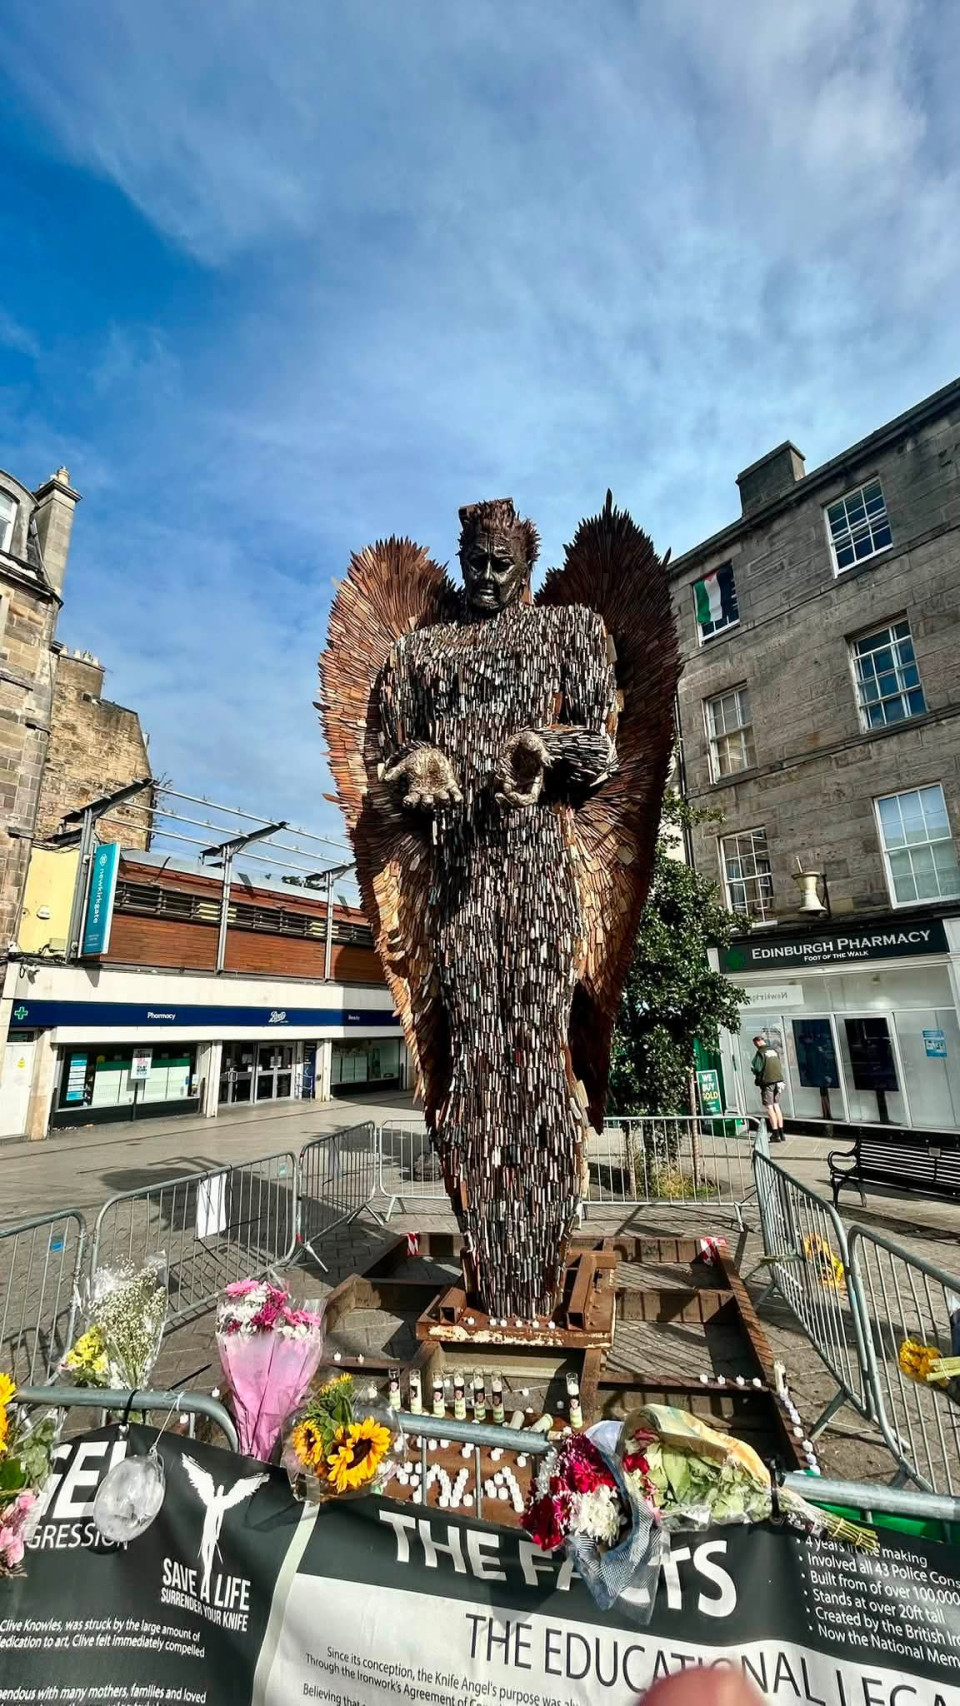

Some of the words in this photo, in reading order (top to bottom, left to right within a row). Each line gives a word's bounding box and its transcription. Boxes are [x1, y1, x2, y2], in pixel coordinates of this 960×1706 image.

[93, 868, 105, 923] newkirkgate
[752, 941, 834, 960] EDINBURGH
[837, 930, 931, 951] PHARMACY
[847, 950, 870, 958] WALK
[147, 1011, 176, 1021] Pharmacy
[268, 1011, 287, 1023] Boots
[702, 1073, 713, 1082] WE
[702, 1082, 715, 1092] BUY
[378, 1509, 507, 1582] THE
[805, 1535, 813, 1548] 4
[814, 1537, 845, 1552] years
[882, 1547, 928, 1568] making
[807, 1552, 857, 1572] Involved
[859, 1559, 873, 1575] all
[875, 1563, 890, 1578] 43
[891, 1563, 928, 1582] Police
[162, 1557, 198, 1597] SAVE
[214, 1573, 251, 1611] LIFE
[810, 1570, 837, 1587] Built
[838, 1573, 867, 1592] from
[869, 1581, 882, 1596] of
[884, 1585, 911, 1599] over
[912, 1585, 960, 1606] 100,000
[160, 1587, 203, 1616] SURRENDER
[203, 1604, 222, 1626] YOUR
[222, 1611, 249, 1632] KNIFE
[813, 1588, 852, 1607] Stands
[854, 1596, 866, 1609] at
[869, 1601, 896, 1617] over
[899, 1603, 925, 1622] 20ft
[924, 1606, 946, 1625] tall
[0, 1619, 23, 1632] Clive
[23, 1618, 63, 1632] Knowles,
[65, 1619, 83, 1631] was
[84, 1617, 111, 1631] struck
[113, 1617, 124, 1634] by
[126, 1618, 140, 1632] the
[141, 1619, 161, 1636] large
[161, 1625, 191, 1640] amount
[192, 1632, 201, 1643] of
[466, 1613, 532, 1670] THE
[815, 1606, 862, 1627] Created
[863, 1613, 879, 1633] by
[881, 1619, 903, 1637] the
[905, 1623, 946, 1645] British
[43, 1636, 54, 1648] to
[54, 1635, 71, 1649] art,
[72, 1633, 94, 1647] Clive
[95, 1633, 111, 1647] felt
[112, 1634, 165, 1652] immediately
[165, 1640, 205, 1658] compelled
[818, 1624, 846, 1642] Now
[847, 1630, 869, 1647] the
[870, 1637, 925, 1660] National
[926, 1647, 960, 1668] Mem
[305, 1653, 340, 1675] Through
[341, 1665, 356, 1679] the
[357, 1670, 401, 1693] Ironwork's
[403, 1683, 456, 1706] Agreement
[327, 1646, 350, 1663] Since
[351, 1653, 361, 1666] its
[363, 1658, 415, 1681] conception,
[417, 1667, 433, 1684] the
[435, 1671, 460, 1689] Knife
[461, 1677, 498, 1698] Angel's
[500, 1687, 540, 1706] purpose
[38, 1686, 60, 1700] with
[60, 1687, 88, 1702] many
[88, 1684, 129, 1699] mothers,
[130, 1682, 164, 1698] families
[165, 1687, 183, 1700] and
[183, 1688, 207, 1704] loved
[303, 1682, 342, 1706] Believing
